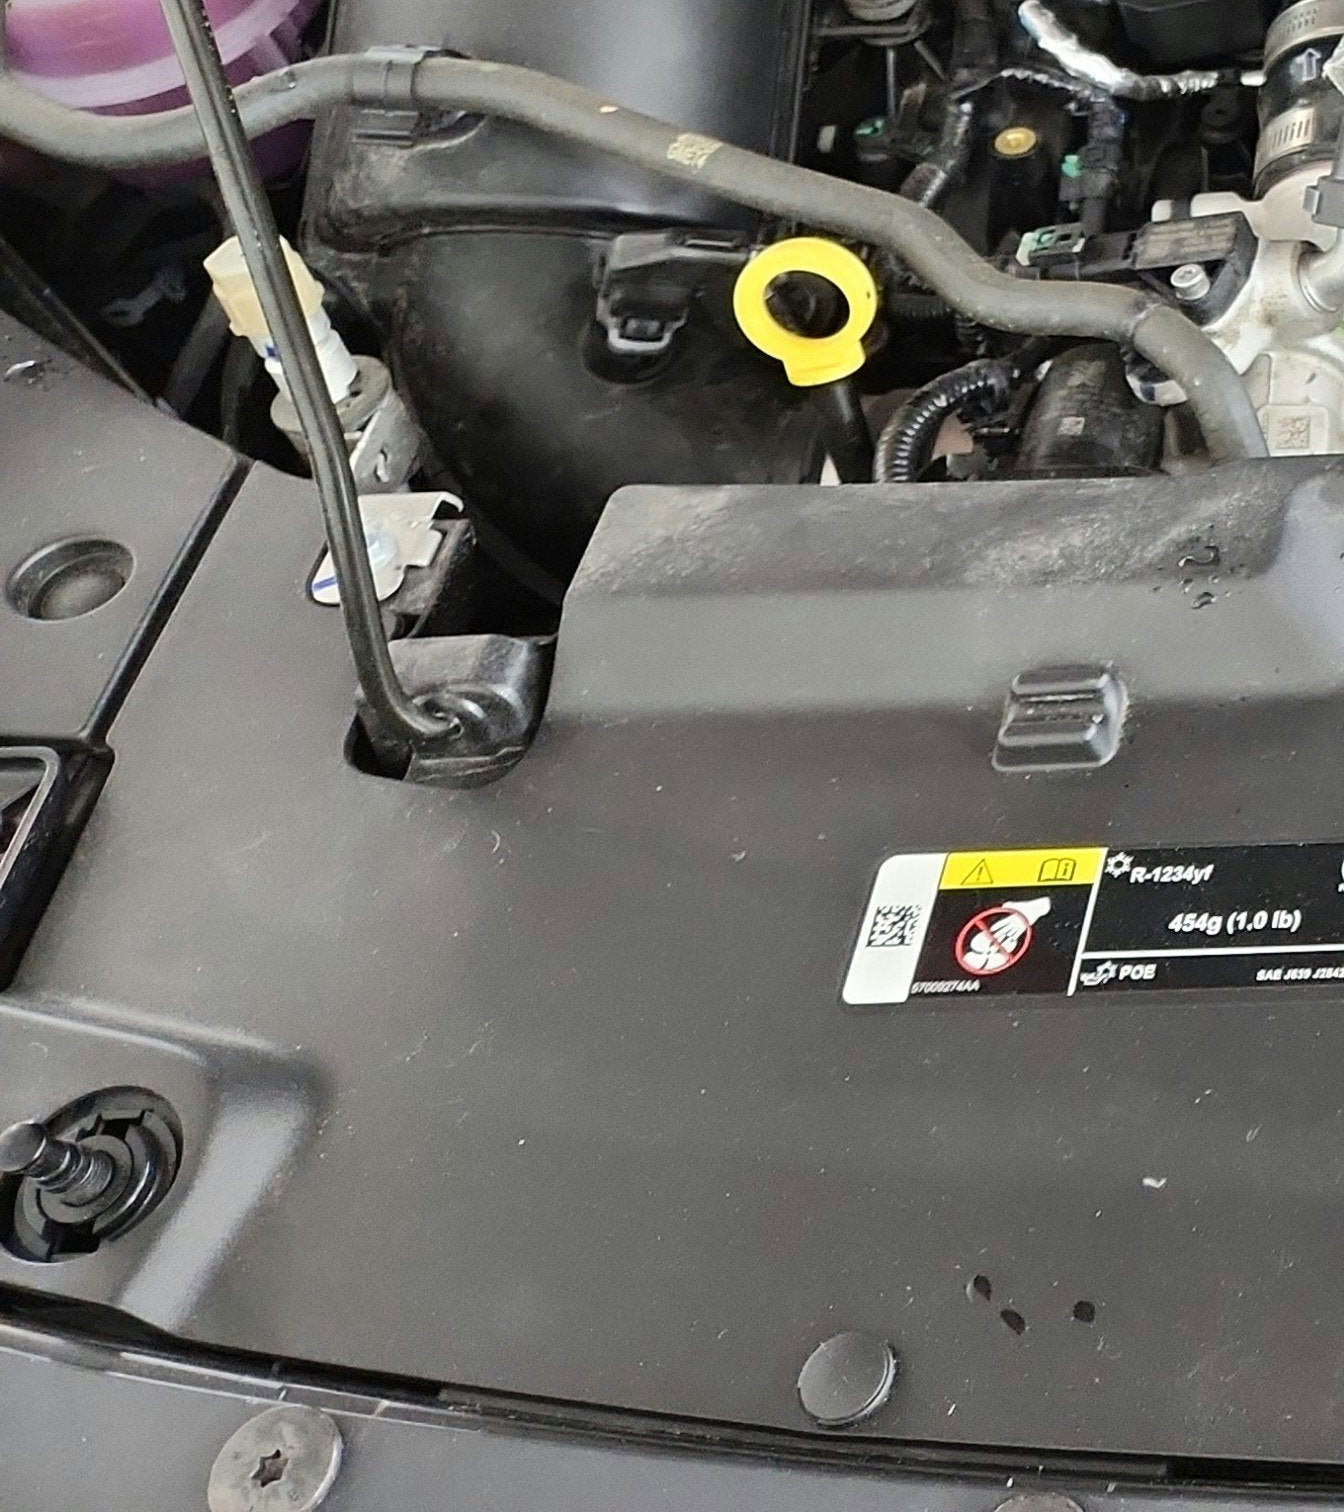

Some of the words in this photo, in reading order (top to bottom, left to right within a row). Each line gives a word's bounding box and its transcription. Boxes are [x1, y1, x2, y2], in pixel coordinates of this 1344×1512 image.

[1130, 864, 1214, 885] R-1234yf
[1168, 911, 1224, 936] 454g
[1226, 910, 1268, 935] (1.0
[1272, 909, 1302, 933] lb)
[1119, 963, 1157, 980] POE
[1256, 968, 1281, 981] SAE
[1283, 968, 1312, 981] J639
